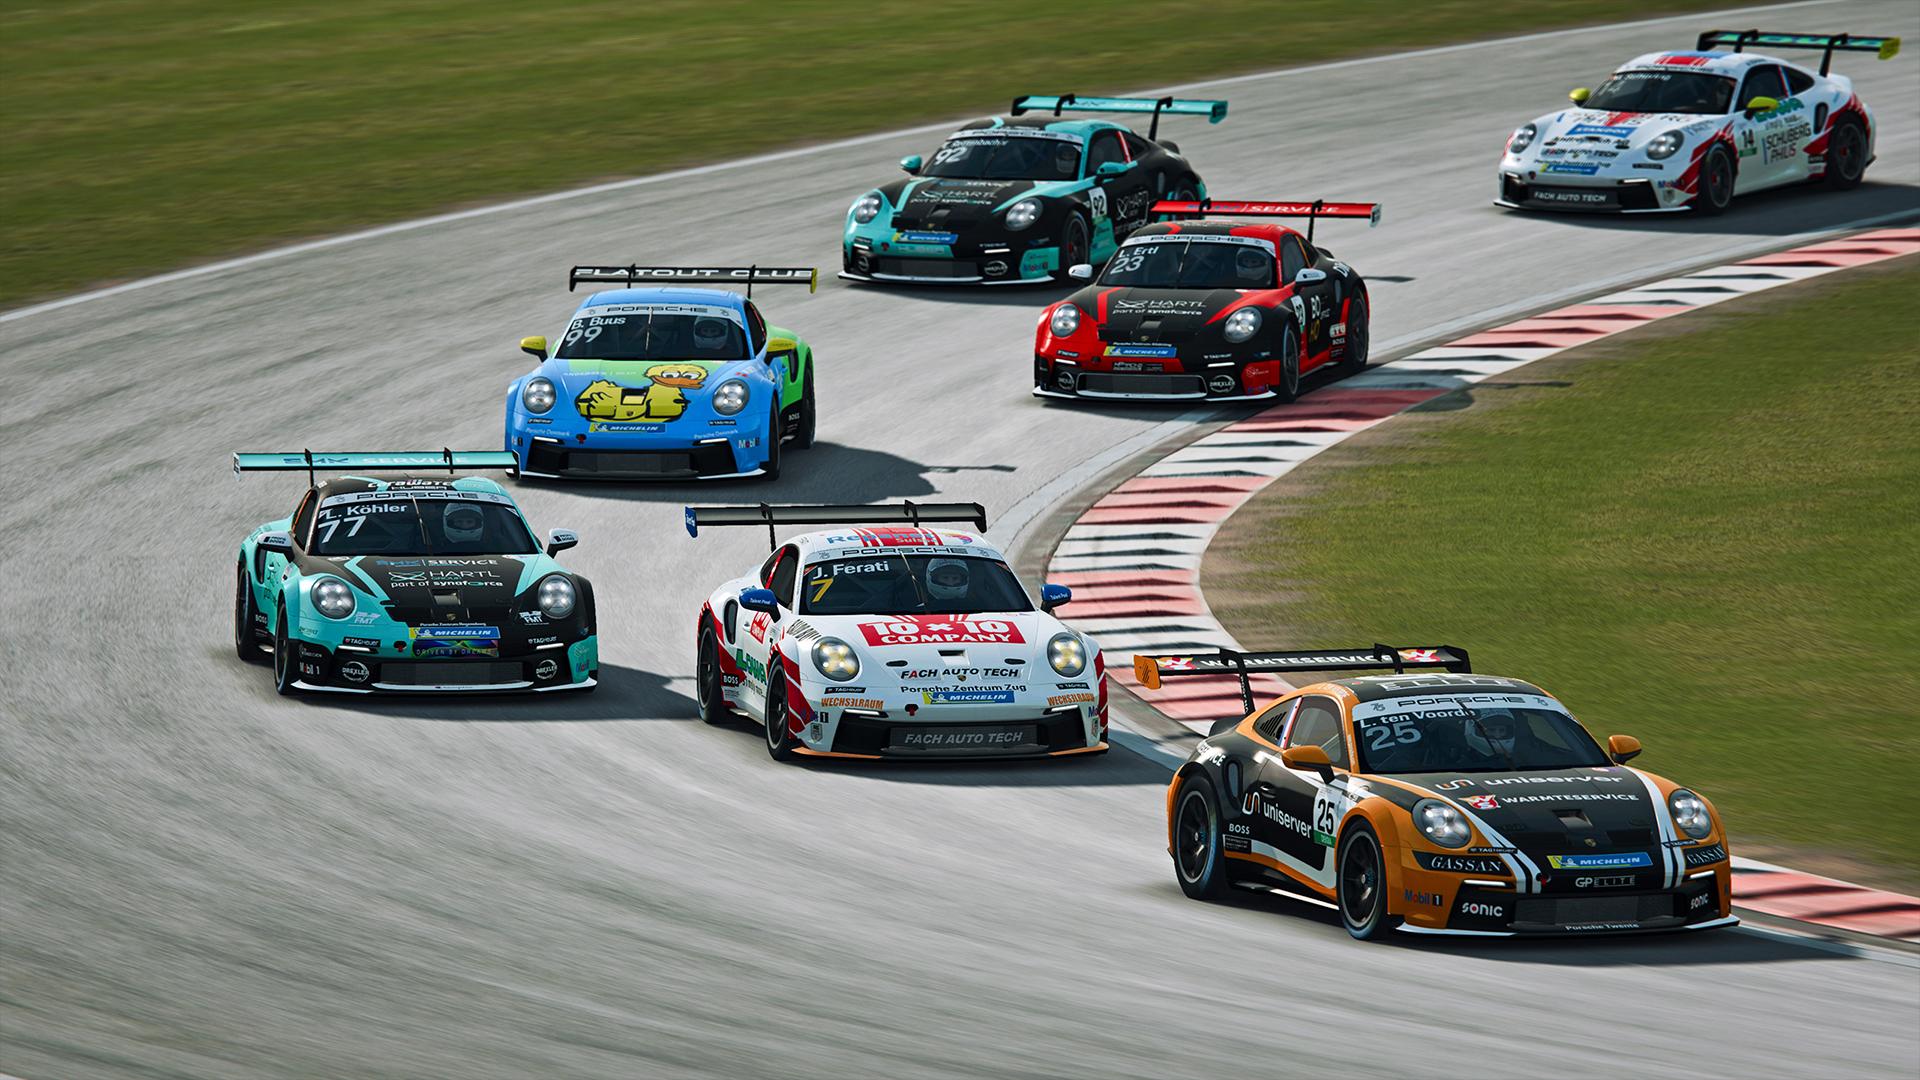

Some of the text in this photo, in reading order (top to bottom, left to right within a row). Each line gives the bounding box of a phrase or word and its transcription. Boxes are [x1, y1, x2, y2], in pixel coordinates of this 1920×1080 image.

[1741, 128, 1755, 148] 14
[1766, 122, 1812, 149] SCHUBERG
[934, 147, 968, 166] 92
[1534, 191, 1607, 202] FACH AUTO TECH
[1092, 195, 1105, 216] 92
[1246, 204, 1340, 213] SERVICE
[1150, 235, 1244, 243] PORSCHE
[1117, 246, 1158, 258] L. Ertl
[1109, 255, 1144, 275] 23
[573, 268, 812, 278] FLATOUT CLUB
[606, 305, 708, 313] PORSCHE
[1149, 300, 1206, 308] HARTL
[571, 316, 627, 331] B. Buus
[565, 326, 603, 347] 99
[357, 491, 479, 501] PORSCHE
[324, 503, 408, 520] L. Köhler
[317, 515, 367, 544] 77
[842, 547, 969, 557] PORSCHE
[429, 570, 500, 578] HARTL
[812, 561, 890, 580] J. Ferati
[391, 581, 415, 589] part
[810, 577, 834, 603] 7
[880, 632, 1011, 645] COMPANY
[900, 667, 1019, 680] FACH AUTO TECH
[723, 675, 739, 685] BOSS
[900, 683, 1027, 693] Porsche Zentrum Zug
[949, 693, 1007, 701] MICHELIN
[1398, 696, 1526, 708] PORSCHE
[1360, 720, 1376, 729] L.
[1382, 713, 1410, 725] ten
[904, 731, 1023, 744] FACH AUTO TECH
[1364, 720, 1422, 752] 25
[1483, 775, 1624, 787] uniserver
[1501, 793, 1640, 804] WARMTESERVICE
[1263, 801, 1312, 839] uniserver
[1317, 798, 1335, 836] 25
[1228, 823, 1250, 835] BOSS
[1431, 855, 1501, 873] GASSAN
[1579, 856, 1640, 866] MICHELIN
[1404, 888, 1430, 905] Mobil
[1565, 923, 1604, 931] Porsche
